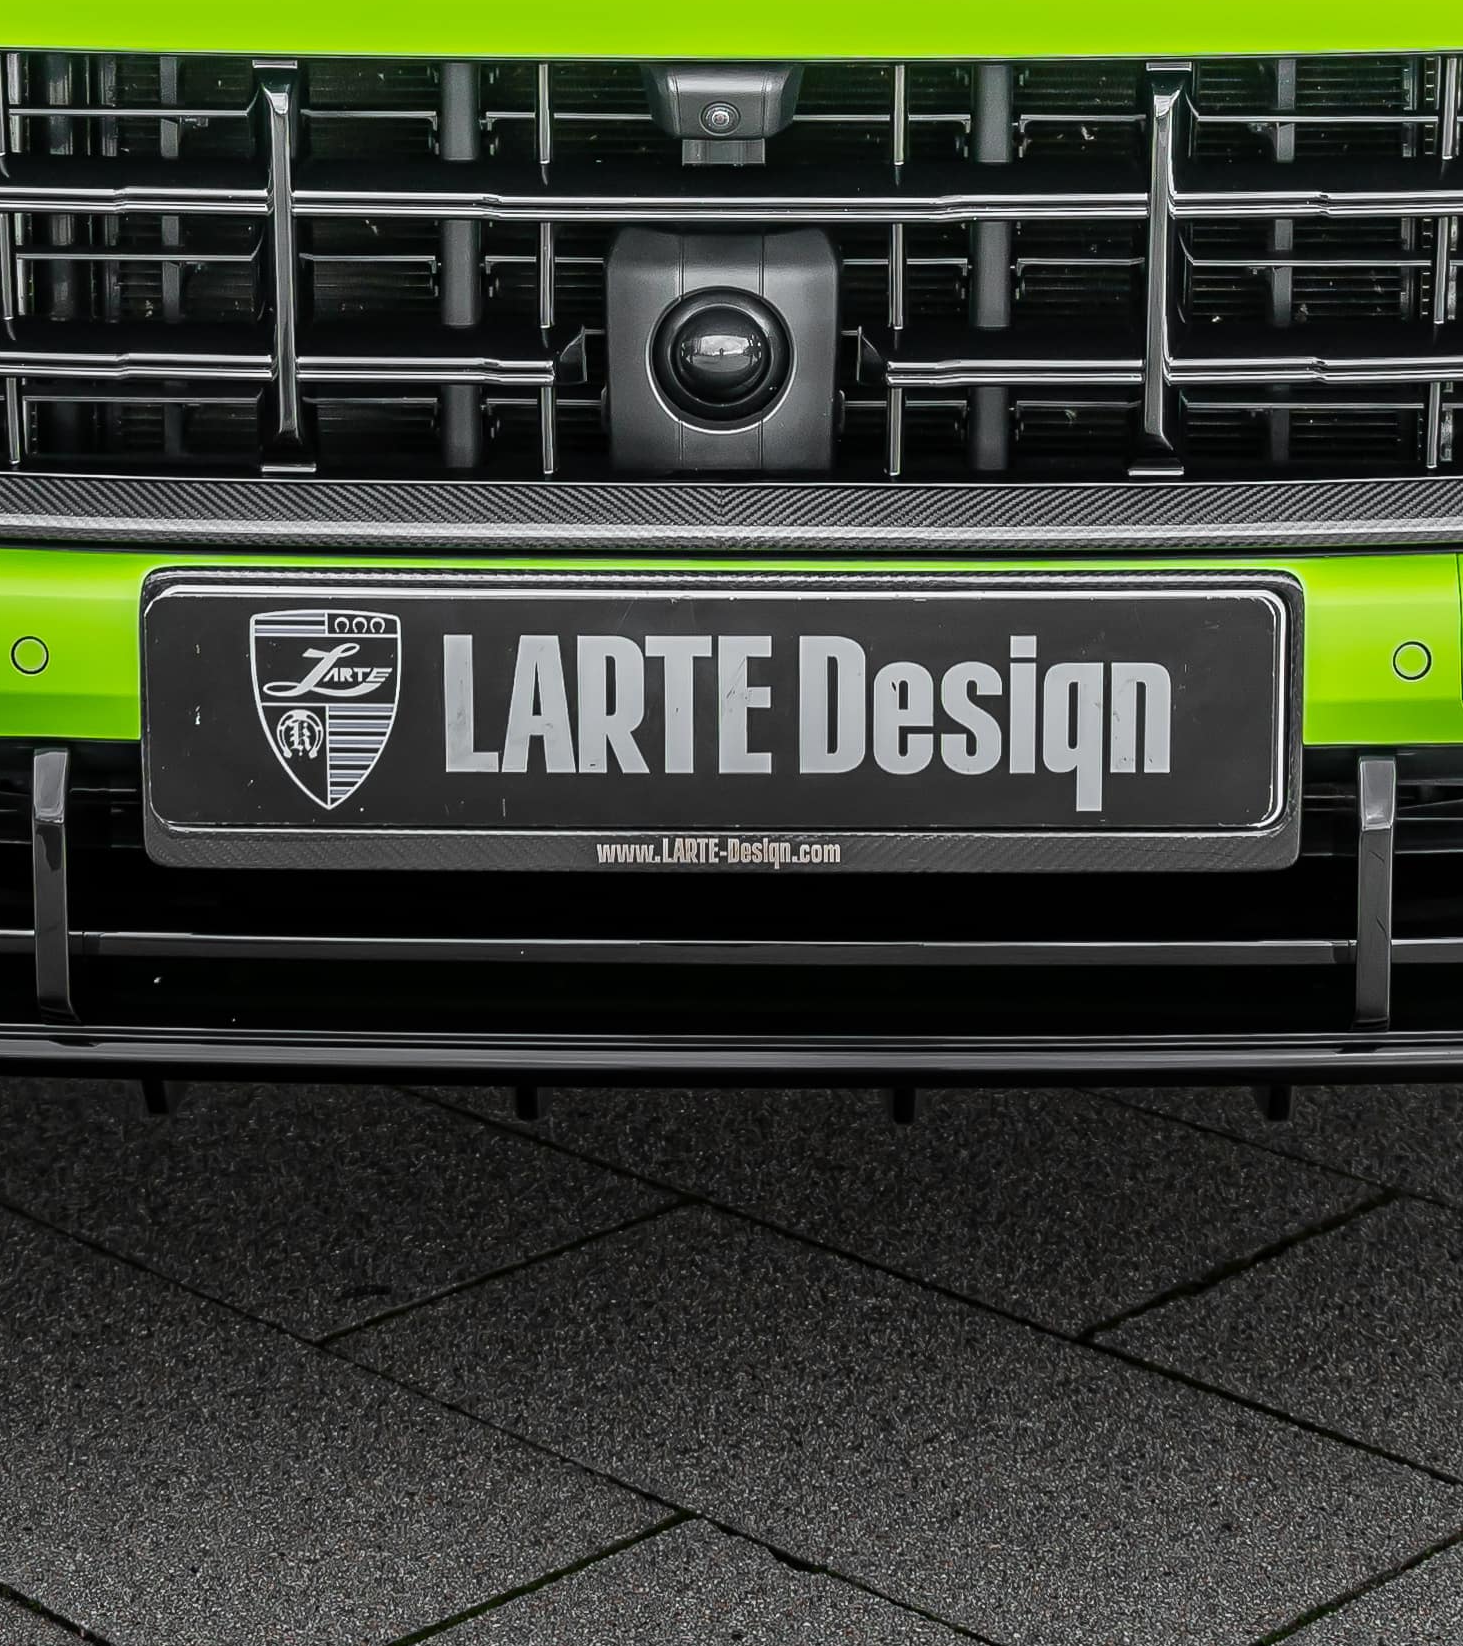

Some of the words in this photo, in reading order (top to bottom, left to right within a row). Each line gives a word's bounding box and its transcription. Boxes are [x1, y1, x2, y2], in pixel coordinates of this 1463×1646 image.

[442, 633, 774, 776] LARTE
[798, 634, 1173, 812] Design
[596, 837, 841, 870] www.LARTE-Design.com
